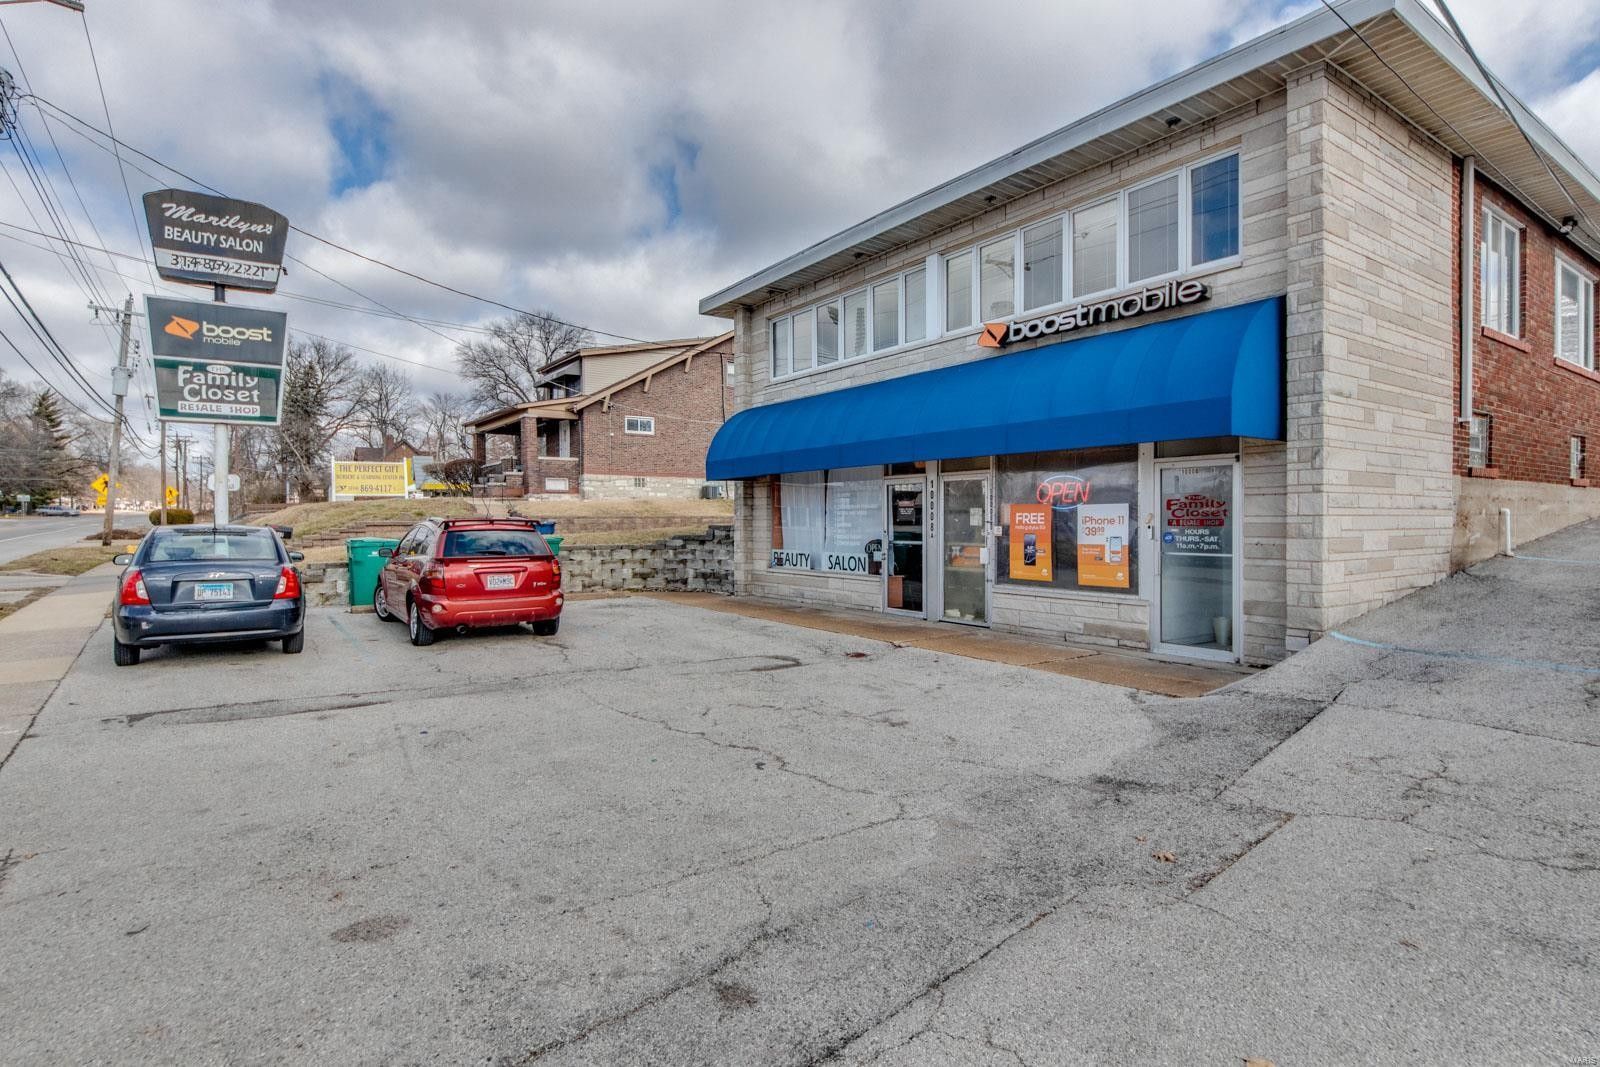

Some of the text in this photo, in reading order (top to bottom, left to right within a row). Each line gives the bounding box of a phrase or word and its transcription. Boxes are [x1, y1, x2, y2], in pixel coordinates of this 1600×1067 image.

[164, 226, 263, 254] BEAUTY SALON
[202, 321, 272, 342] boost
[203, 336, 242, 346] mobile
[177, 365, 258, 388] Family
[183, 384, 260, 403] Closet
[180, 403, 258, 415] RESALE SHOP
[339, 464, 399, 473] THE PERFECT GIFT
[1036, 482, 1091, 504] OPEN
[1166, 499, 1226, 511] Family
[1016, 512, 1045, 524] FREE
[1171, 508, 1228, 518] Closet
[1082, 515, 1124, 525] iPhone 11
[866, 543, 882, 553] OPEN
[773, 551, 866, 572] BEAUTY SALON
